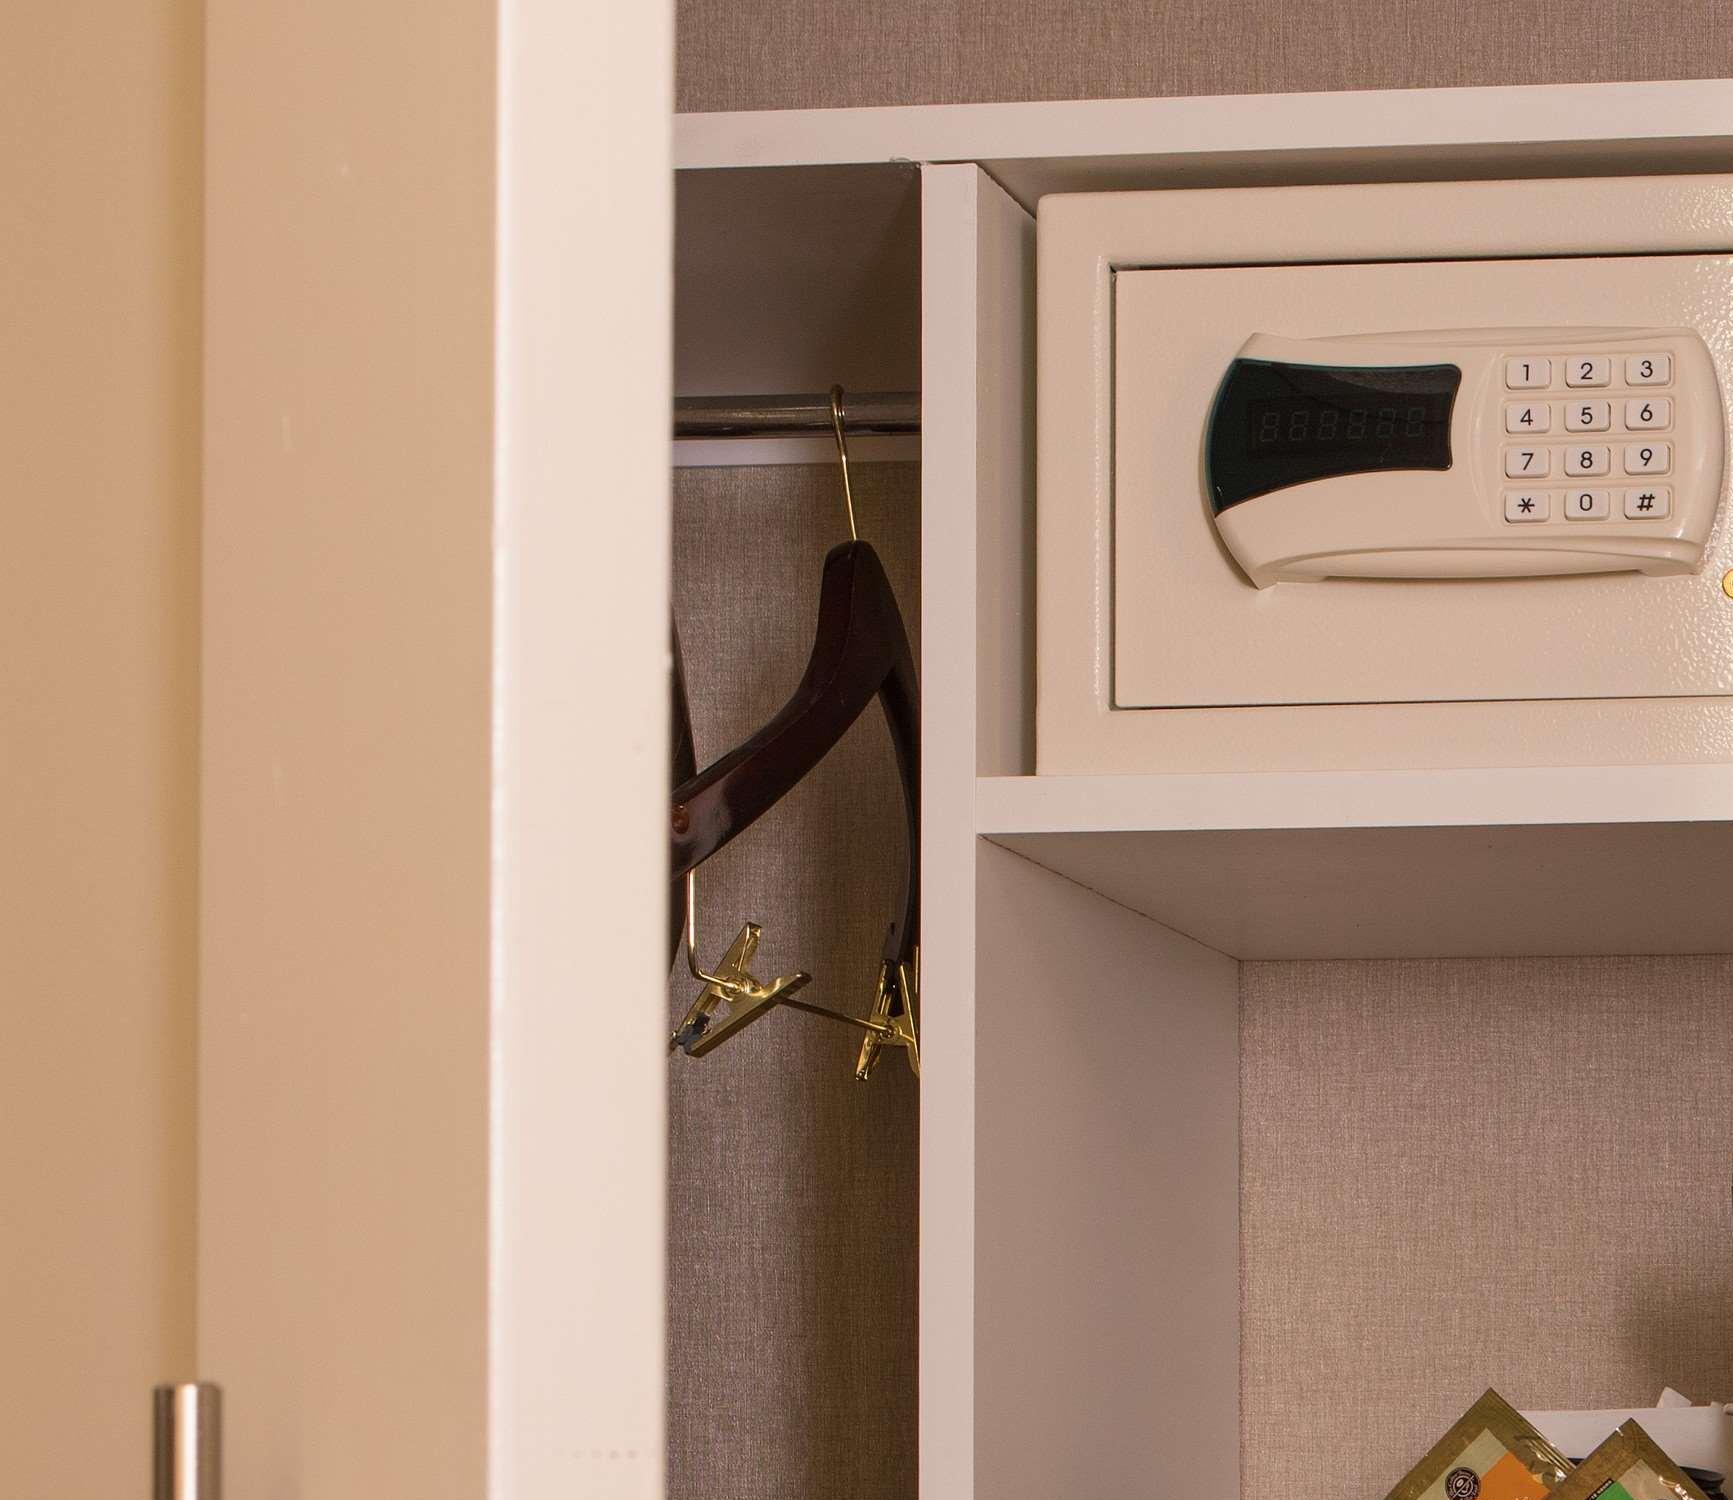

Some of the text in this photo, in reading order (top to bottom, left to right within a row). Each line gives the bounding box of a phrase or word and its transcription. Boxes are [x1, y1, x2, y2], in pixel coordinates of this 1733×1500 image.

[1523, 360, 1653, 381] 1 2 3
[1520, 404, 1653, 426] 4 5 6
[1521, 448, 1653, 470] 7 8 9
[1580, 494, 1655, 511] 0 #
